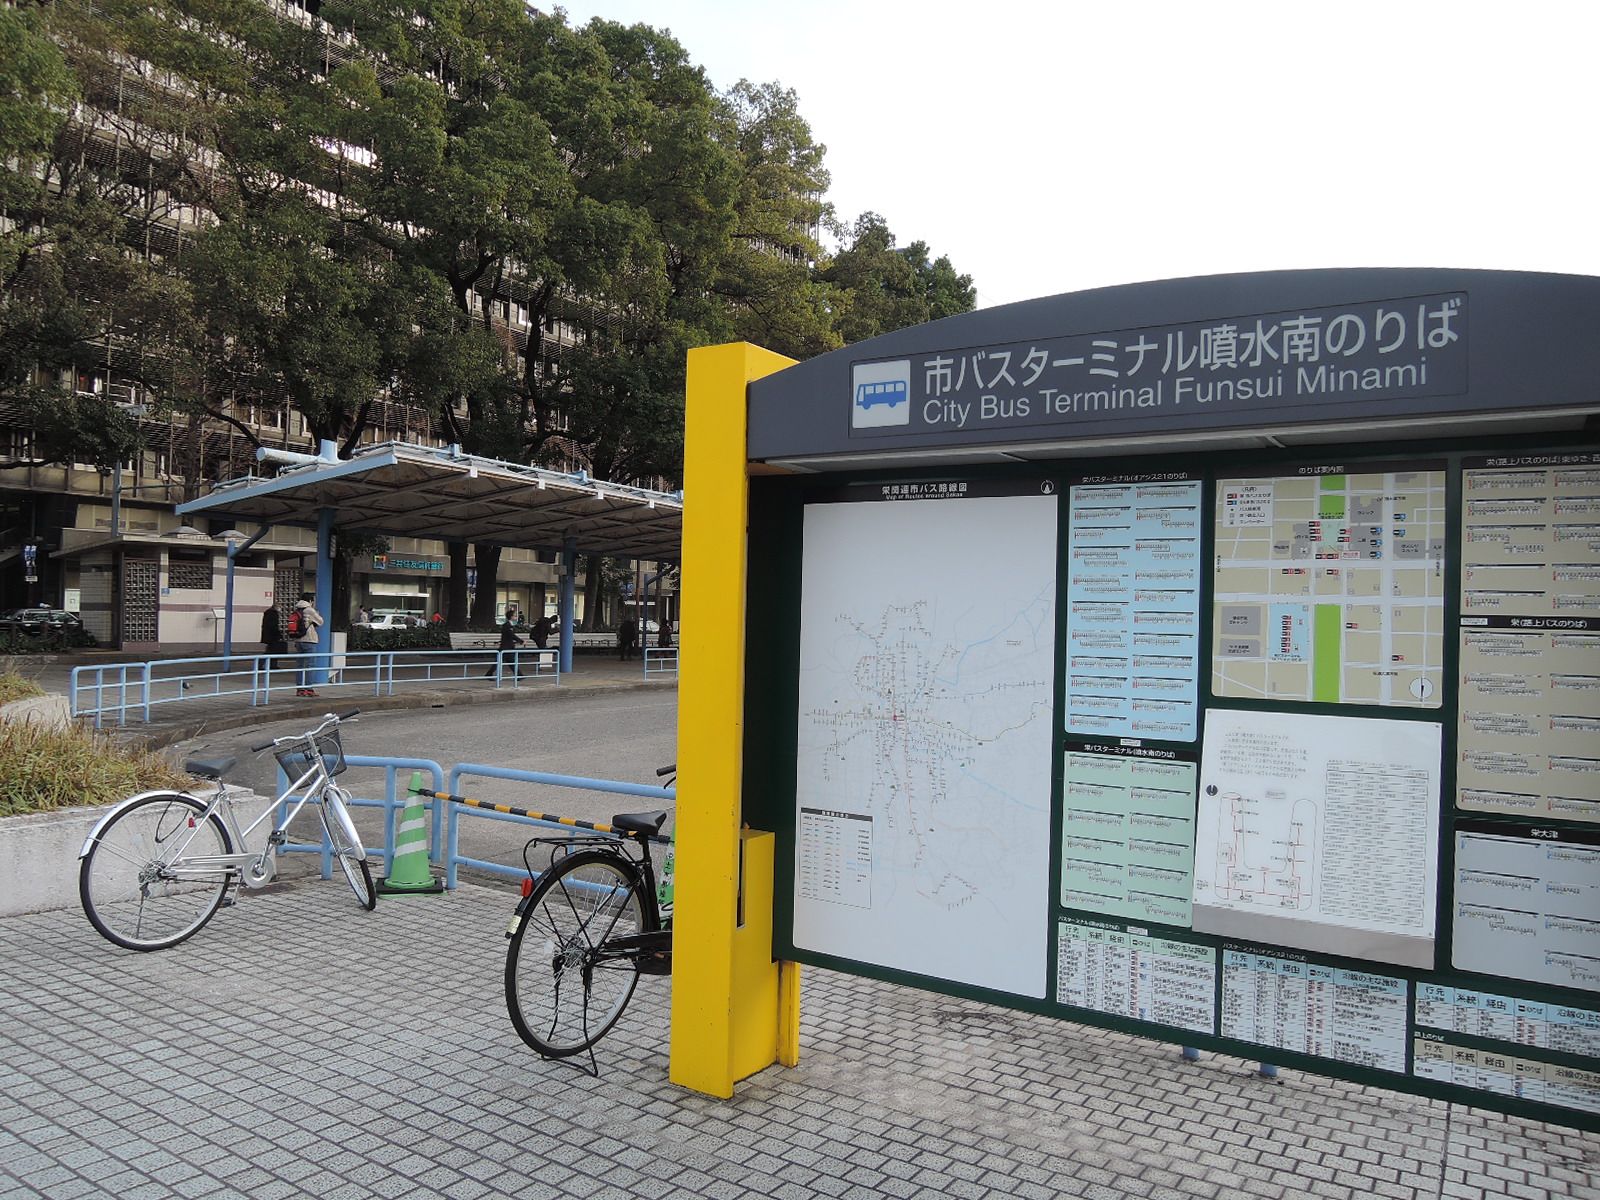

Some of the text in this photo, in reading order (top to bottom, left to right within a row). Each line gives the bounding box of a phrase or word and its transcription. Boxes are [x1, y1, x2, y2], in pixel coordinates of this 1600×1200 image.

[923, 298, 1462, 396] 市バスターミナル噴水南のりば
[922, 356, 1428, 428] City Bus Terminal Funsui Minami
